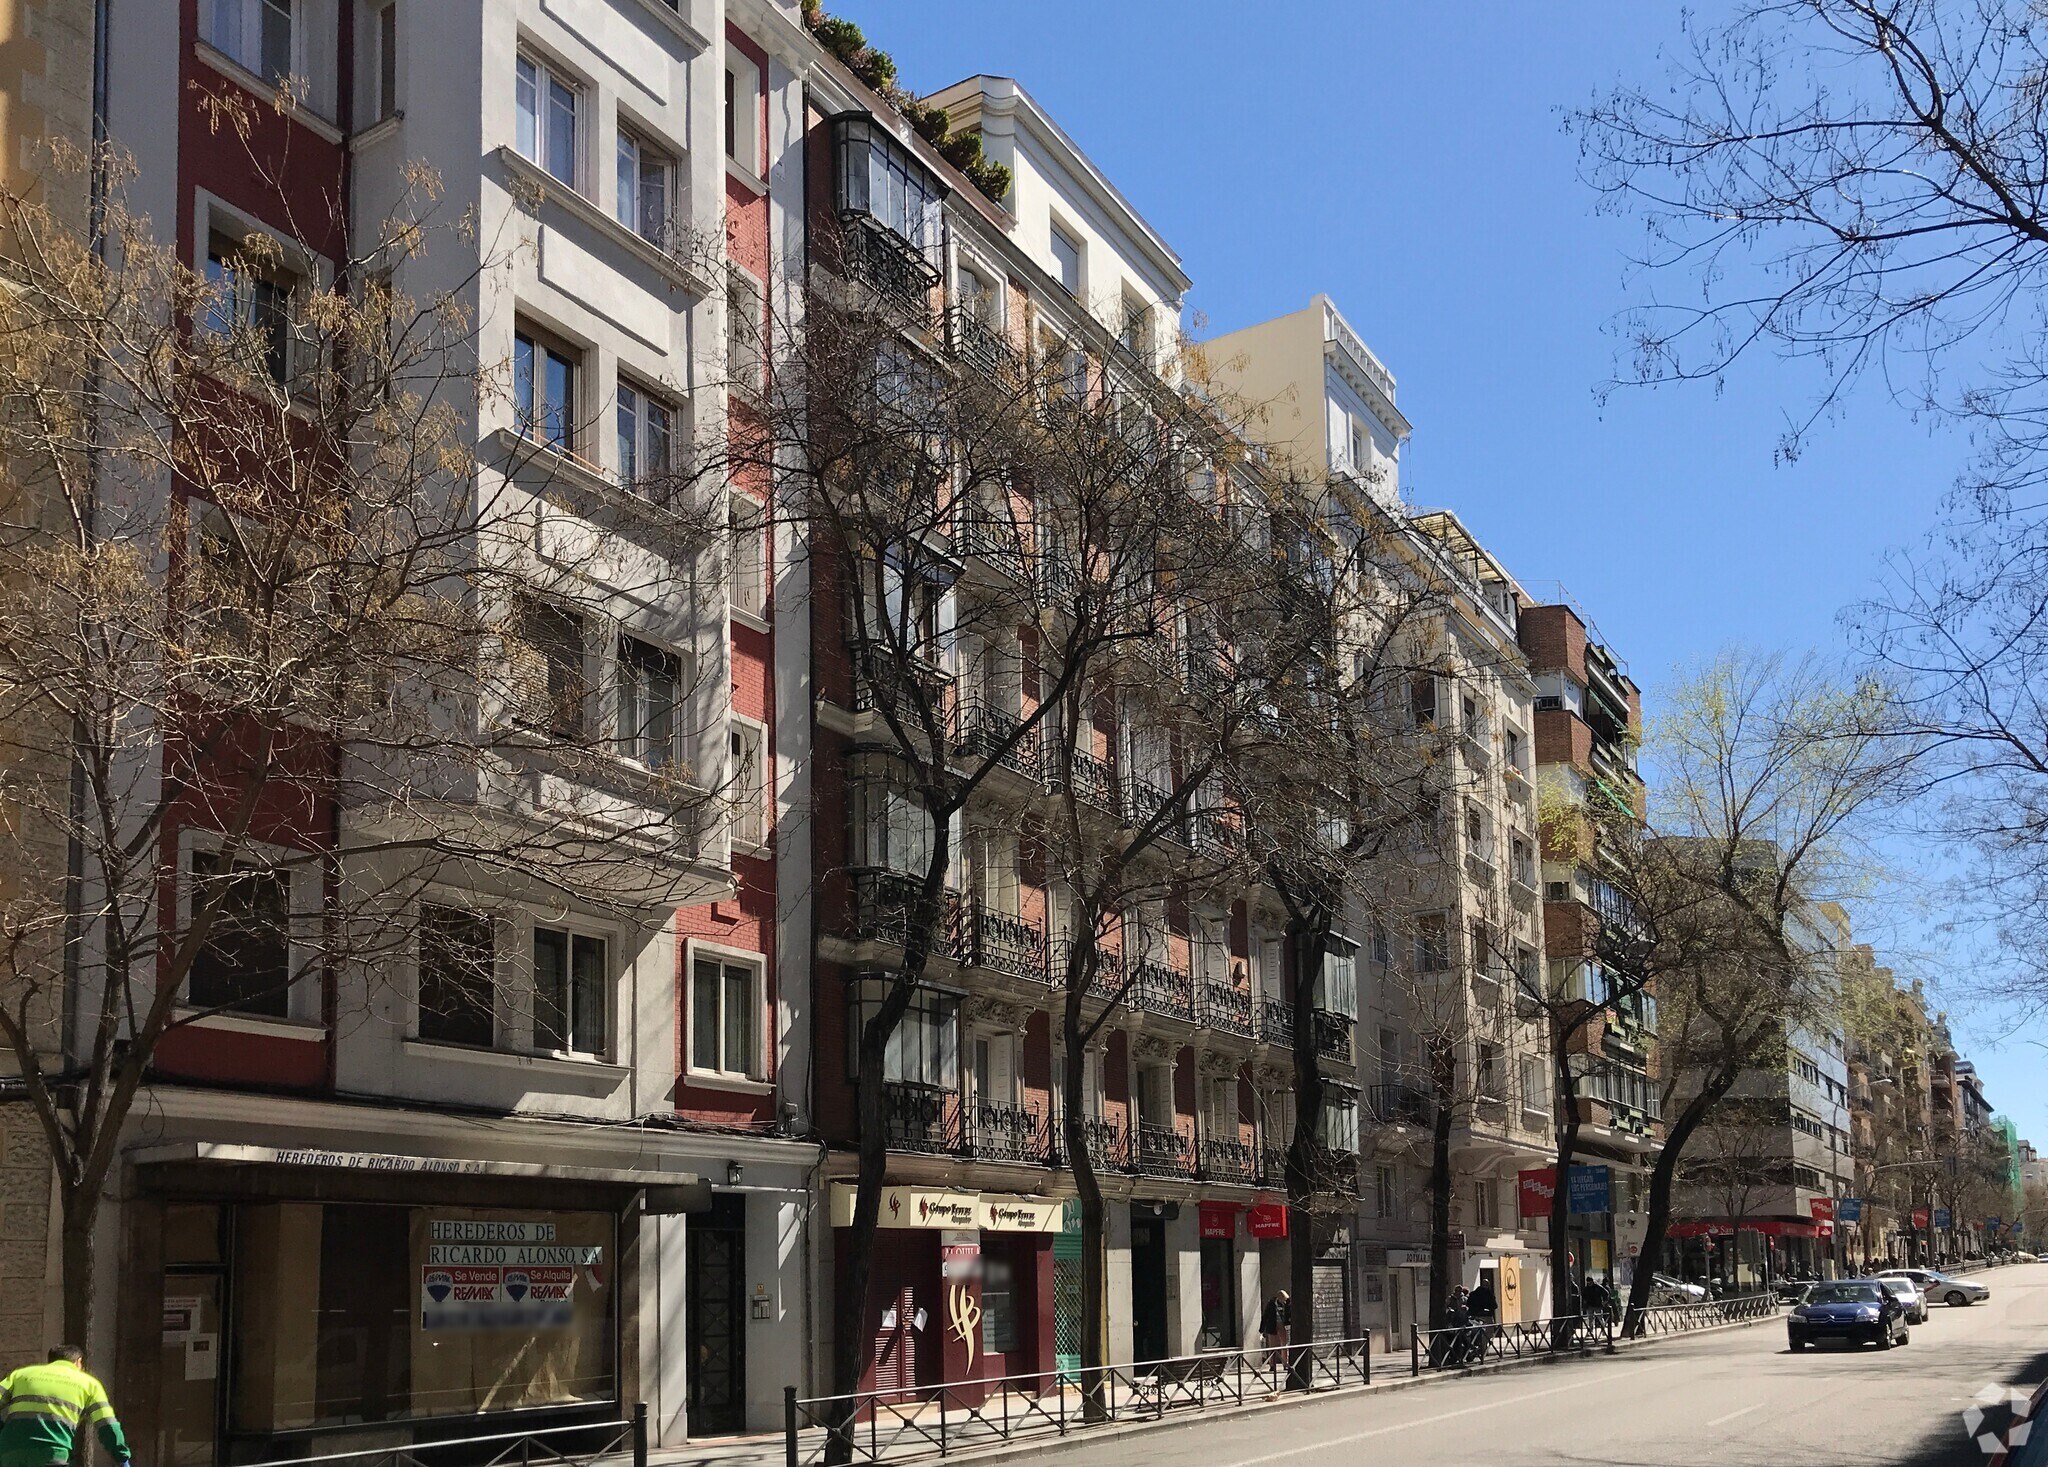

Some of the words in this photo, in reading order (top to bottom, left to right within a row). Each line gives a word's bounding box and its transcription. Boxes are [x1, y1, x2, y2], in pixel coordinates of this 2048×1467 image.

[276, 1151, 343, 1166] HEREDEROS
[348, 1156, 363, 1167] DE
[368, 1157, 415, 1171] RICARDO
[420, 1160, 460, 1173] ALONSO
[431, 1222, 525, 1240] HEREDEROS
[536, 1224, 555, 1241] DE
[1205, 1228, 1226, 1236] MAPFRE
[431, 1247, 506, 1264] RICARDO
[454, 1270, 467, 1281] Se
[469, 1270, 497, 1281] Vende
[530, 1270, 542, 1280] Se
[543, 1270, 571, 1282] Alquila
[454, 1285, 495, 1300] RE/MAX
[530, 1284, 568, 1300] RE/MAX
